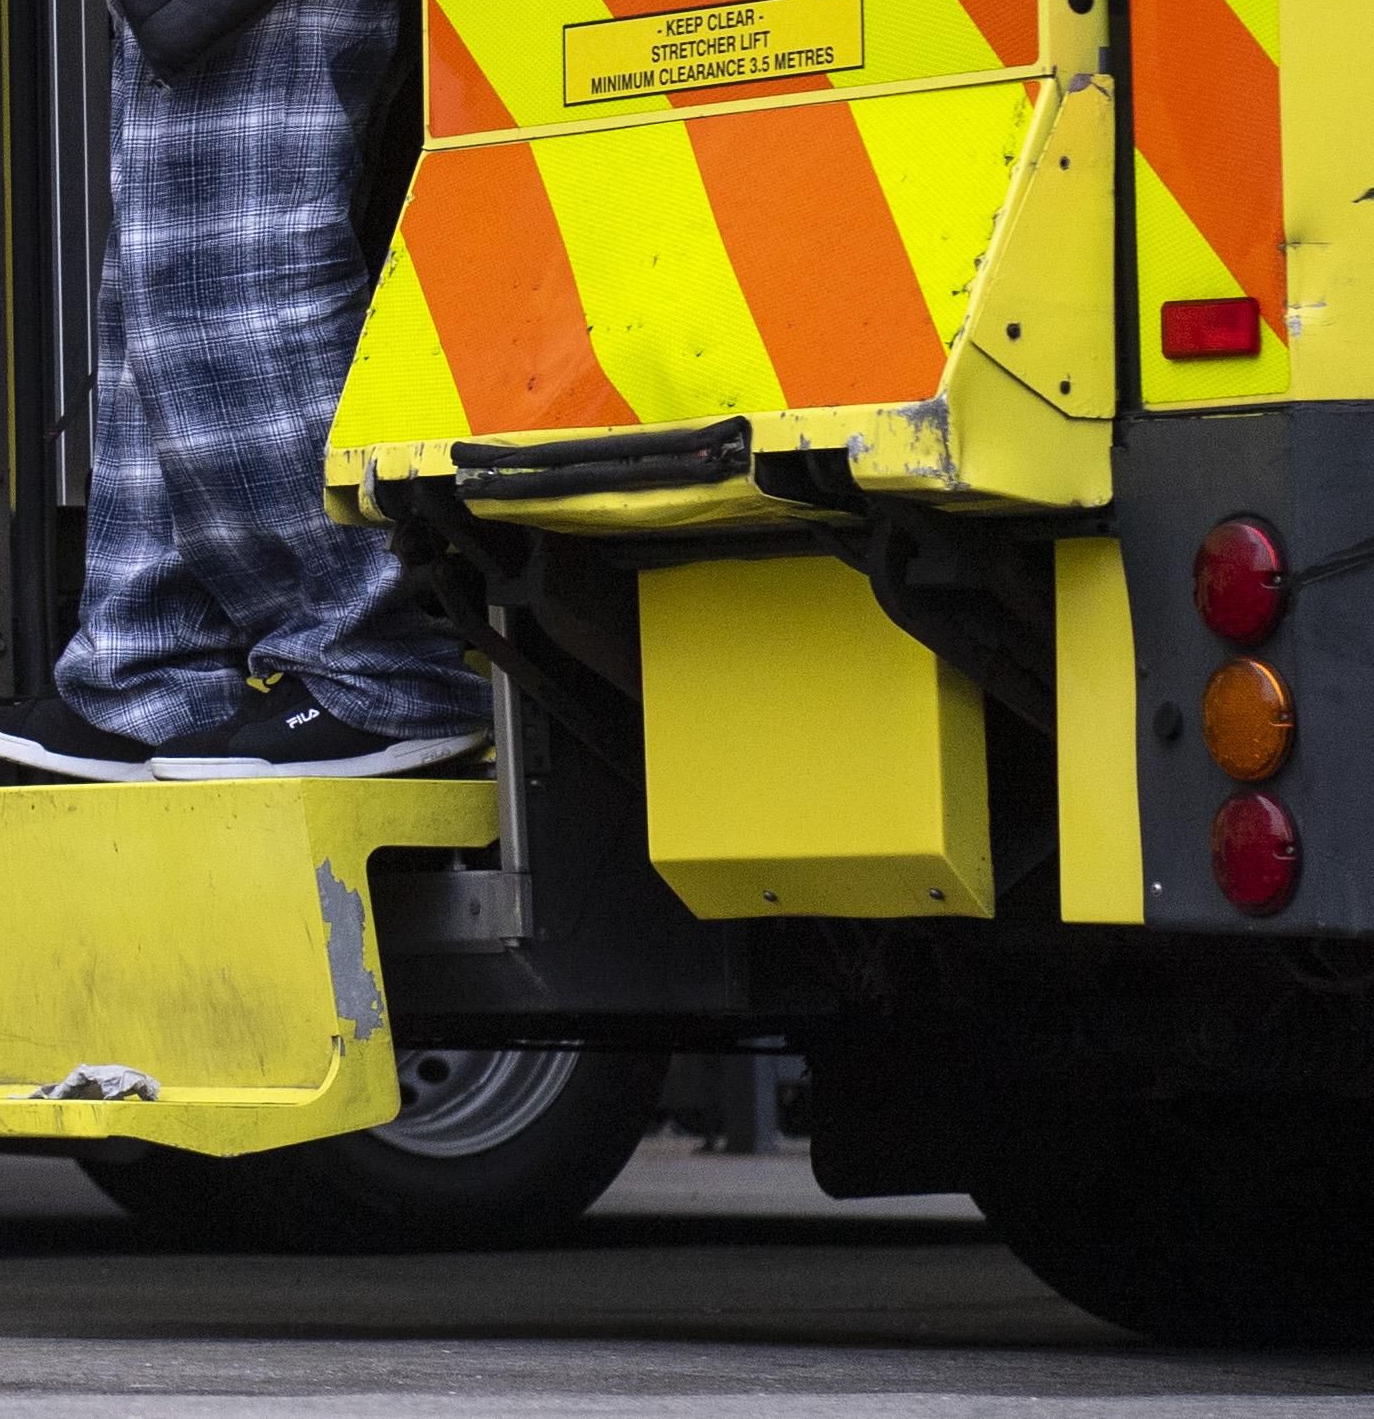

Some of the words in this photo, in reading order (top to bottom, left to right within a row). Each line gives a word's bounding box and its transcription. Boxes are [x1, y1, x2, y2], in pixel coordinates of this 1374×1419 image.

[666, 14, 704, 37] KEEP
[707, 8, 755, 31] CLEAR
[651, 37, 736, 63] STRETCHER
[740, 31, 770, 50] LIFT
[591, 70, 654, 95] MINIMUM
[659, 59, 745, 86] CLEARANCE
[749, 56, 769, 73] 3.5
[774, 46, 835, 71] METRES
[286, 708, 320, 728] FILA
